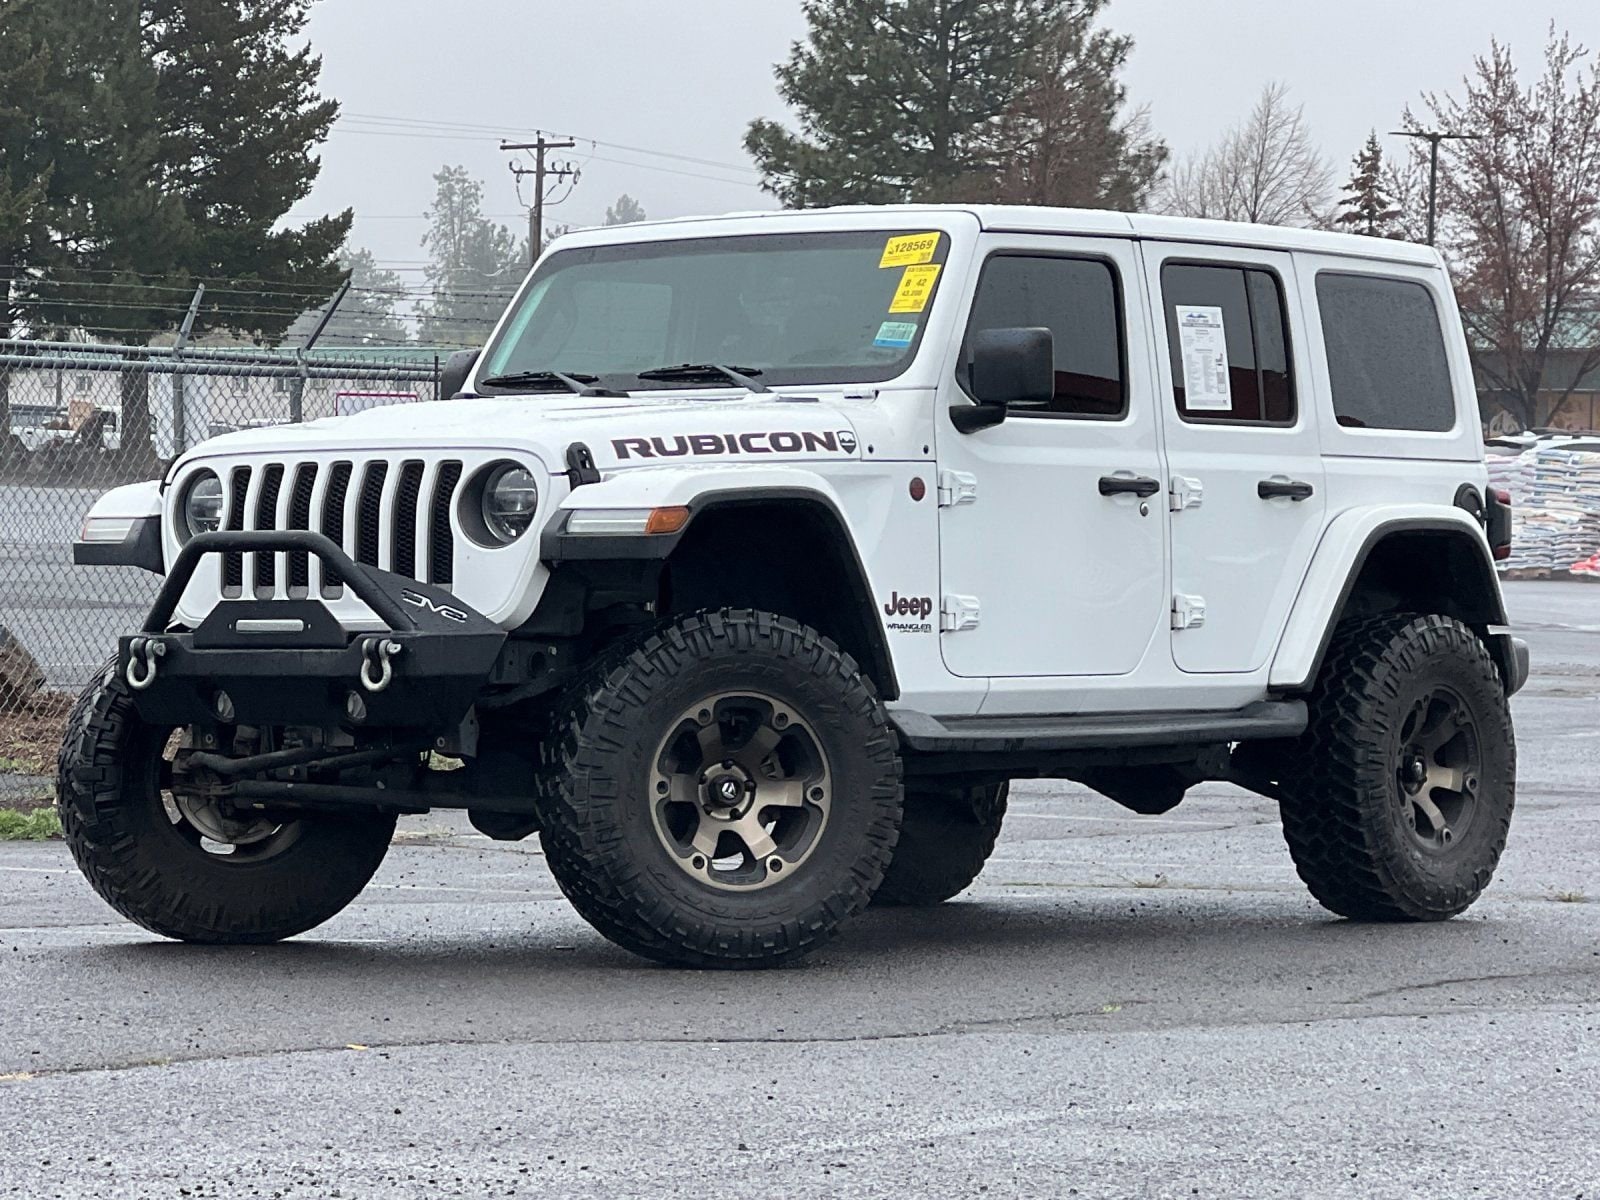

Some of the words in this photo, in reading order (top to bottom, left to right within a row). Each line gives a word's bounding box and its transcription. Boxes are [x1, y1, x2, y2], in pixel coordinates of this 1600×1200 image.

[895, 240, 933, 252] 128569
[916, 278, 927, 286] 42
[610, 431, 838, 459] RUBICON
[885, 592, 932, 620] Jeep
